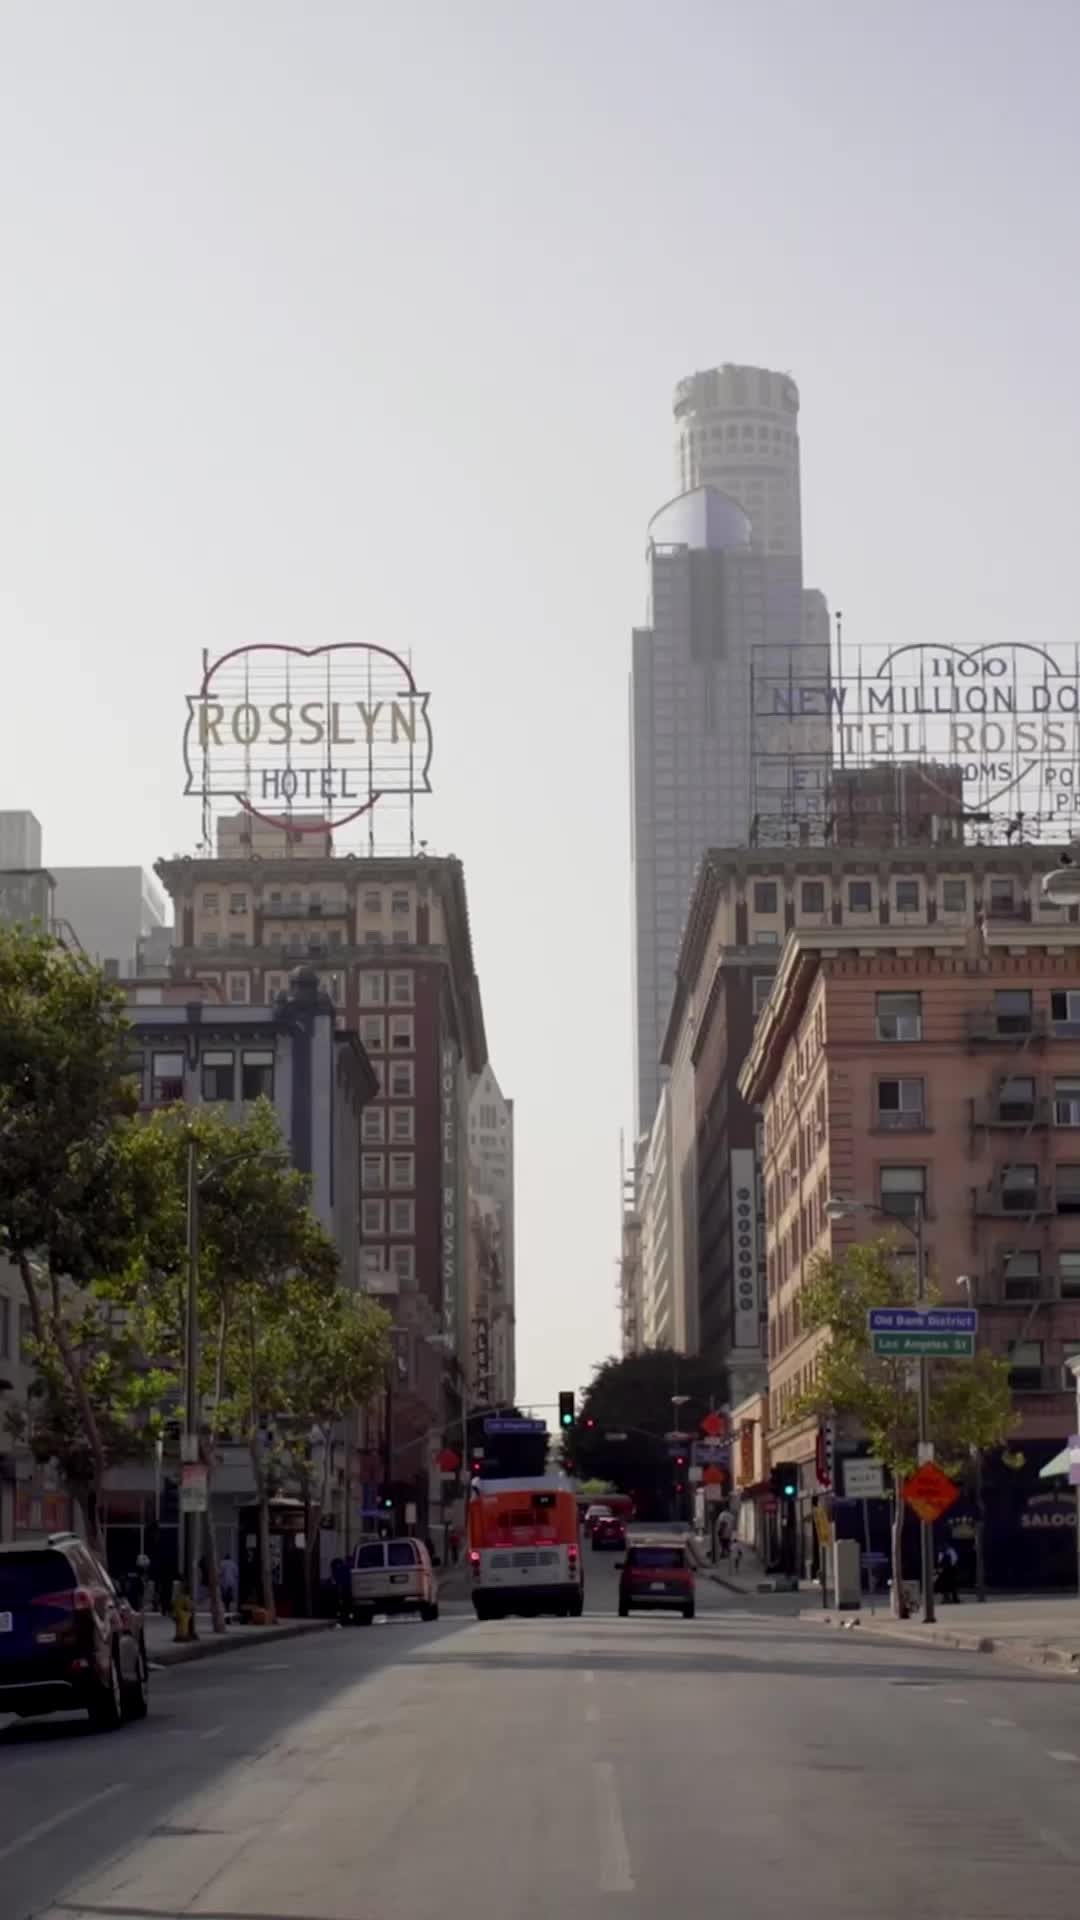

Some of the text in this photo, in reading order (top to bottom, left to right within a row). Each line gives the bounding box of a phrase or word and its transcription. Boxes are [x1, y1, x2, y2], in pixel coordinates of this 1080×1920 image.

[773, 687, 847, 714] NEW
[868, 686, 1013, 714] MILLION
[198, 701, 416, 746] ROSSLYN
[262, 768, 357, 798] HOTEL
[442, 1050, 455, 1164] HOTEL
[873, 1315, 973, 1327] Old Bank District
[879, 1339, 899, 1349] Los
[953, 1339, 967, 1350] St
